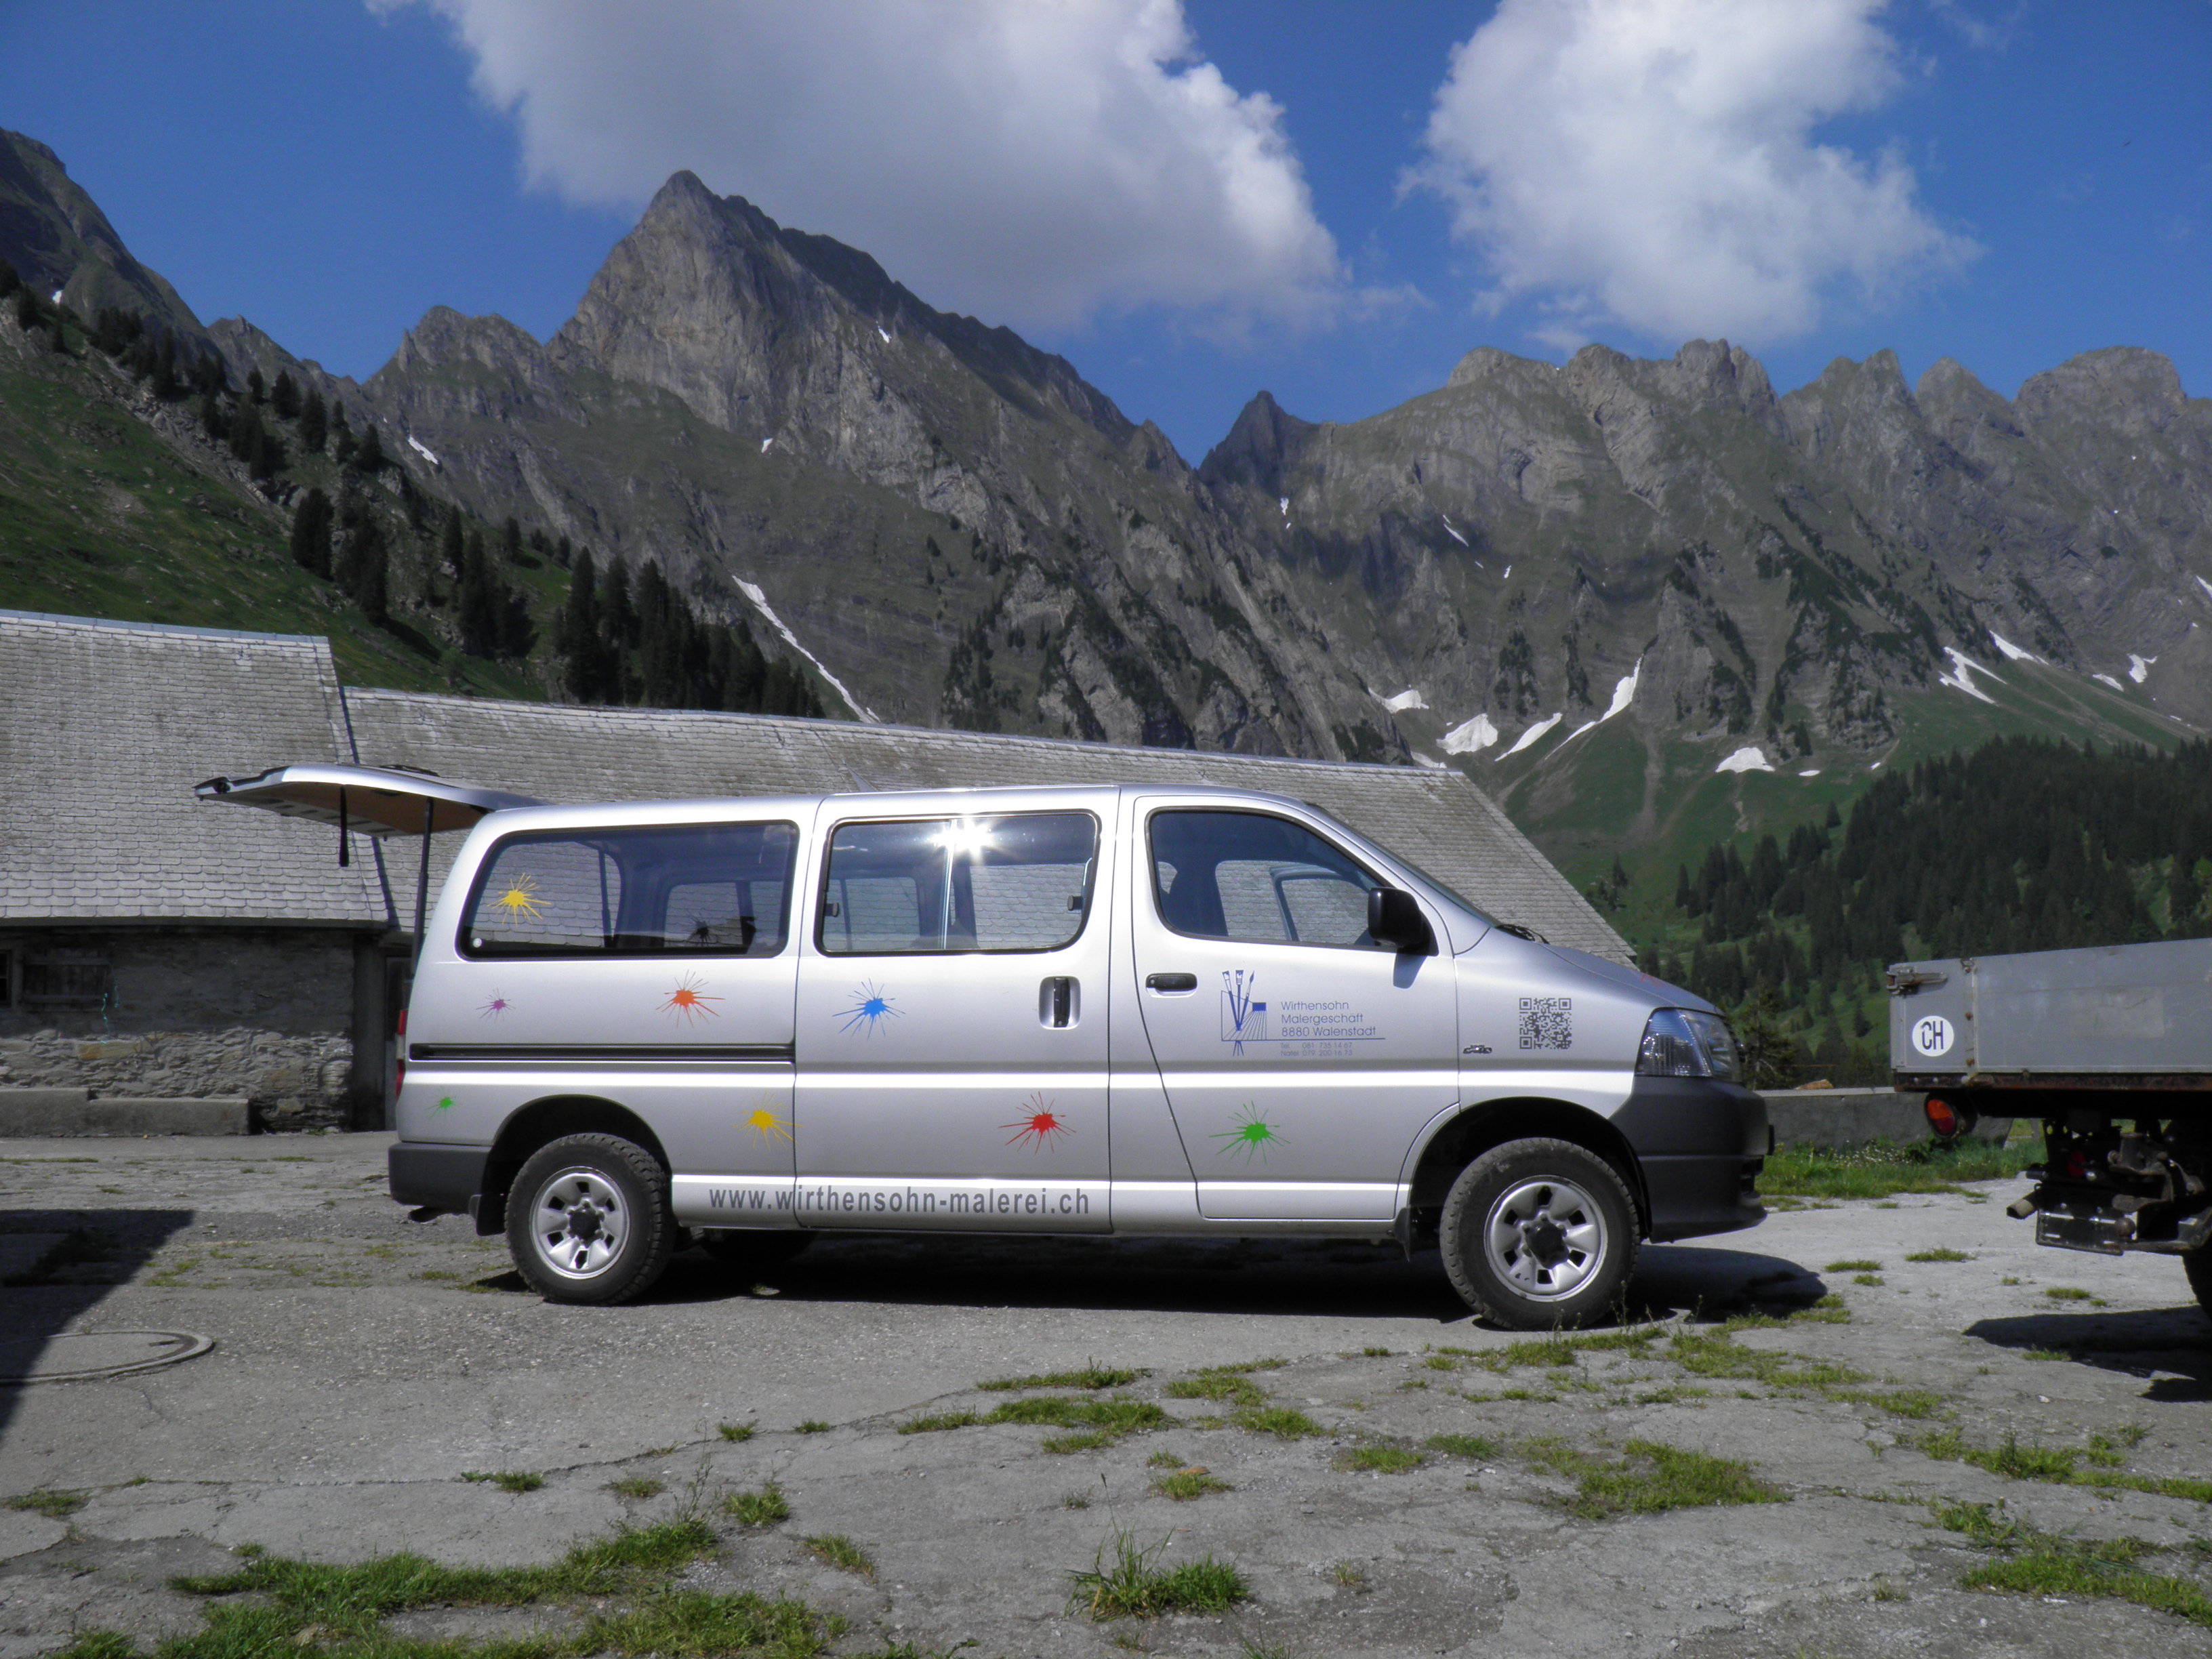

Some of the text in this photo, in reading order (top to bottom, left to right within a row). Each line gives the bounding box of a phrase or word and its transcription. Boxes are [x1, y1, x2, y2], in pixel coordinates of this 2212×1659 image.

[1281, 1001, 1349, 1010] Wirthensohn
[1281, 1013, 1364, 1025] Malergeschäft
[1282, 1026, 1376, 1037] 8880 Walenstadt
[1921, 1020, 1944, 1050] CH
[709, 1185, 1089, 1214] www.wirthensohn-malerei.ch
